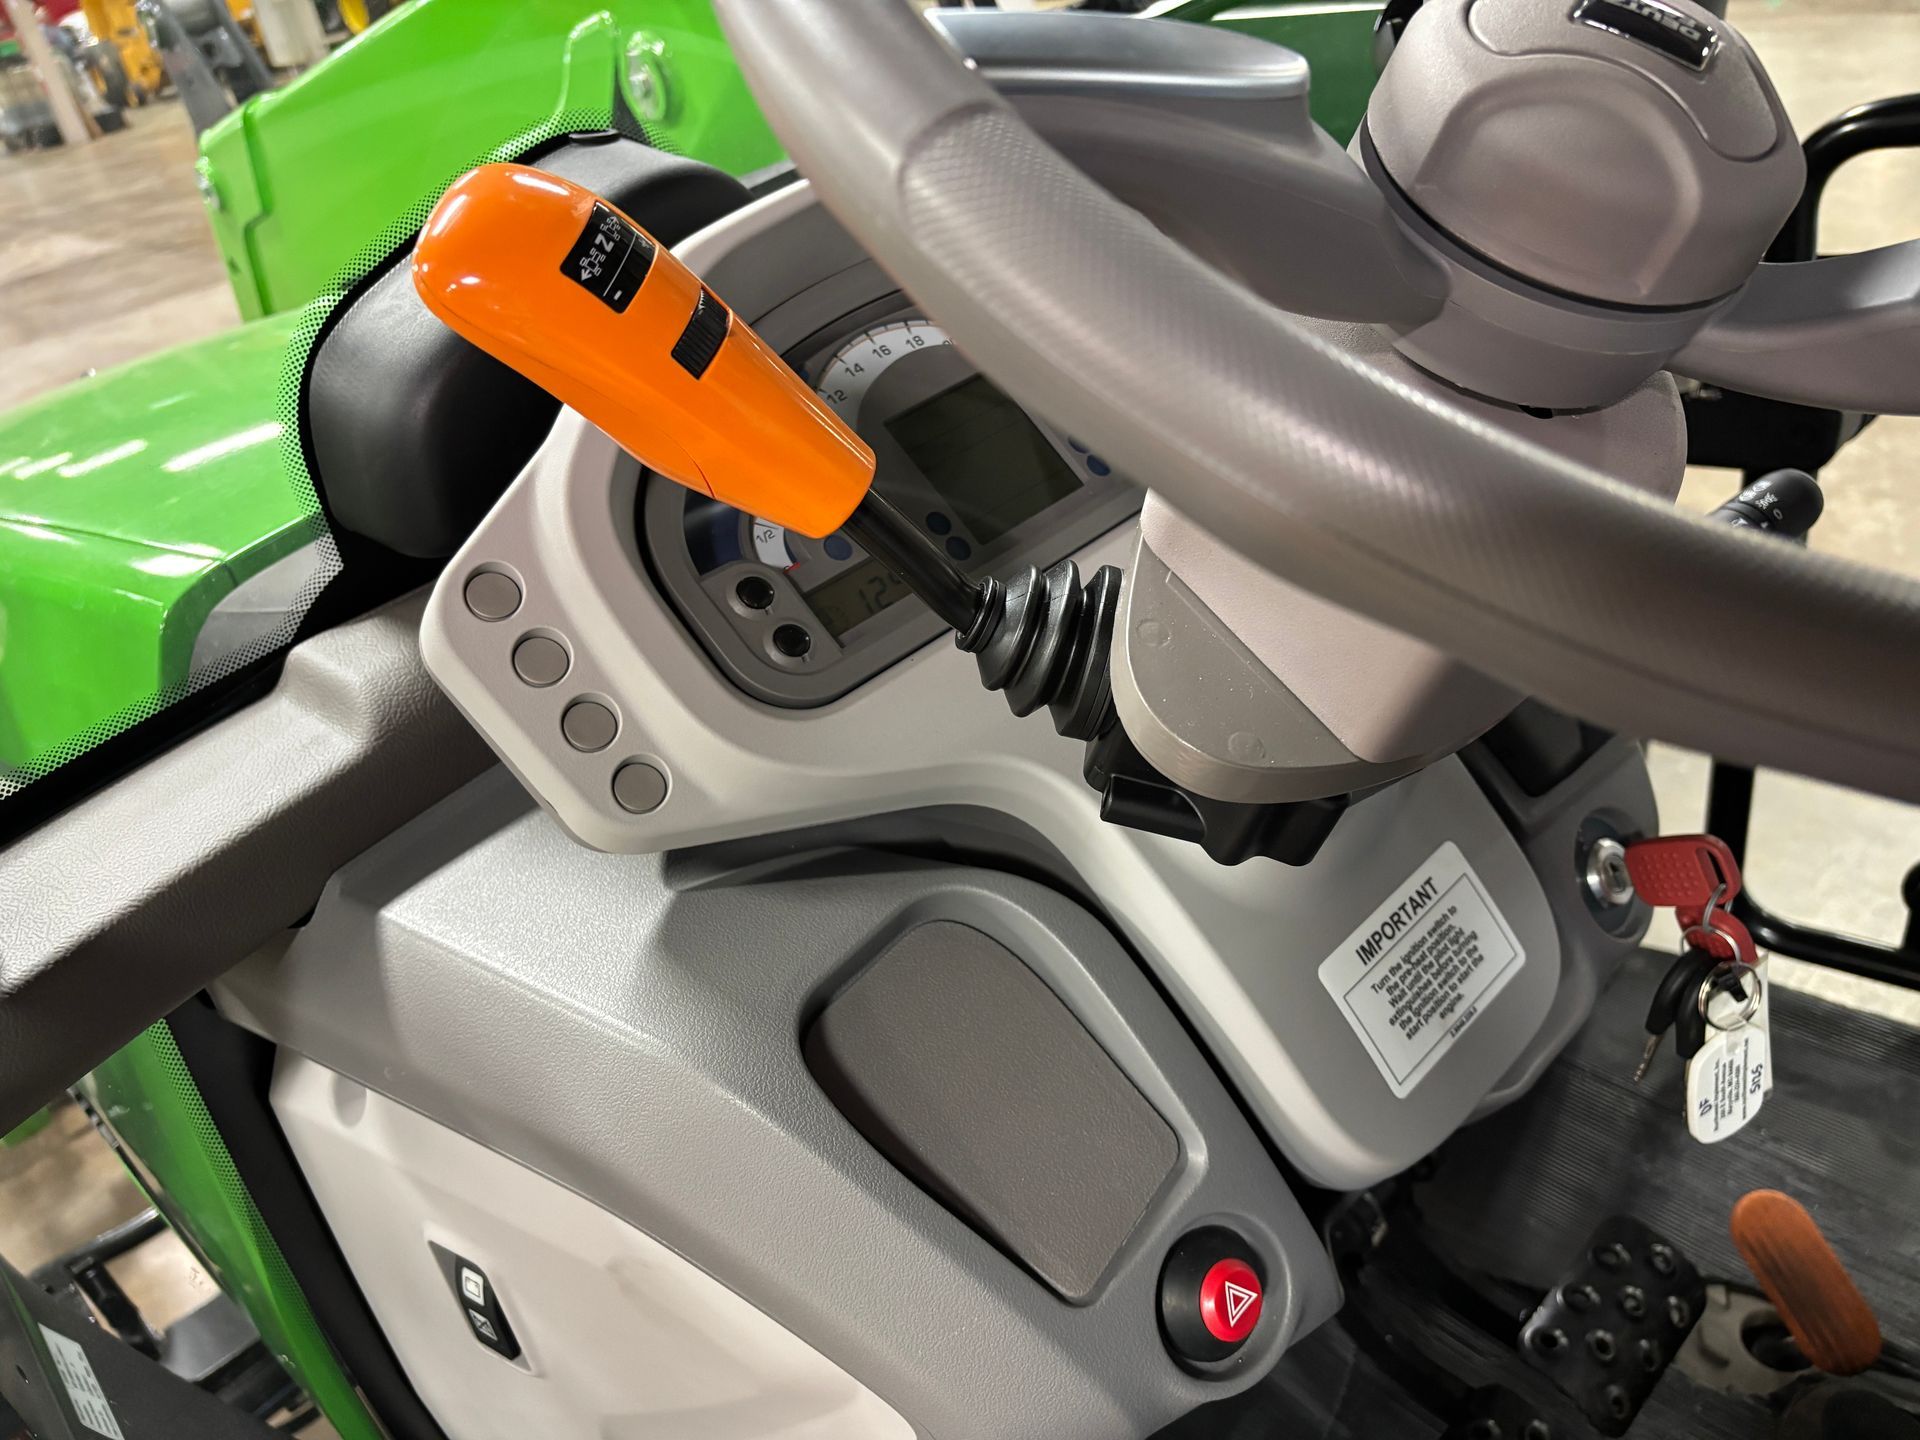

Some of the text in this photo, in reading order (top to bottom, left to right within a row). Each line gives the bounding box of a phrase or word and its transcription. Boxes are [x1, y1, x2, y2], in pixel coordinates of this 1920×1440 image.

[872, 344, 893, 360] 16
[905, 335, 926, 351] 18
[844, 363, 866, 378] 14
[826, 389, 849, 405] 12
[756, 529, 777, 544] 1/2
[1355, 876, 1439, 966] IMPORTANT
[1371, 974, 1391, 994] Turn
[1388, 962, 1402, 977] the
[1427, 914, 1448, 938] switch
[1447, 906, 1457, 916] to
[1430, 955, 1454, 980] before
[1451, 930, 1478, 958] turning
[1389, 927, 1465, 1008] Wait until the pilot light
[1386, 981, 1400, 996] the
[1399, 1015, 1413, 1030] the
[1437, 964, 1460, 990] switch
[1458, 956, 1467, 967] to
[1465, 945, 1478, 958] the
[1406, 1018, 1424, 1040] start
[1448, 982, 1458, 993] to
[1457, 964, 1474, 984] start
[1471, 954, 1484, 968] the
[1439, 993, 1464, 1020] engine.
